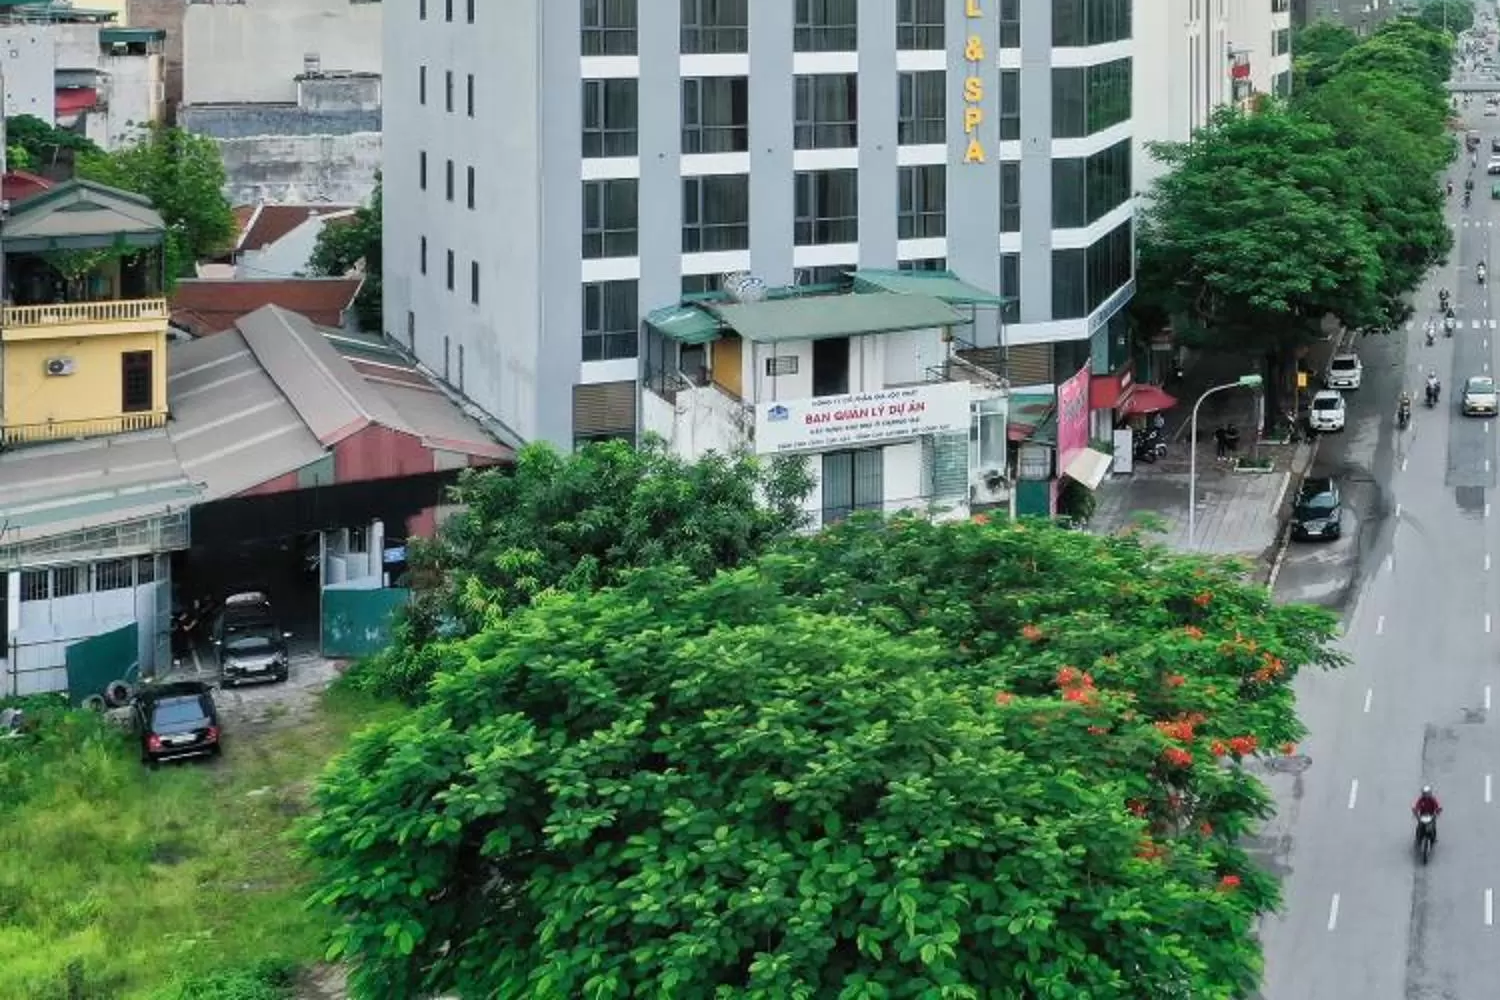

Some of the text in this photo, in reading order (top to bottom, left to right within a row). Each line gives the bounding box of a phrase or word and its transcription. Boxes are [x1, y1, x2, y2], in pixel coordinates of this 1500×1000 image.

[963, 35, 985, 62] &
[962, 75, 985, 164] SPA
[804, 411, 831, 425] BAN
